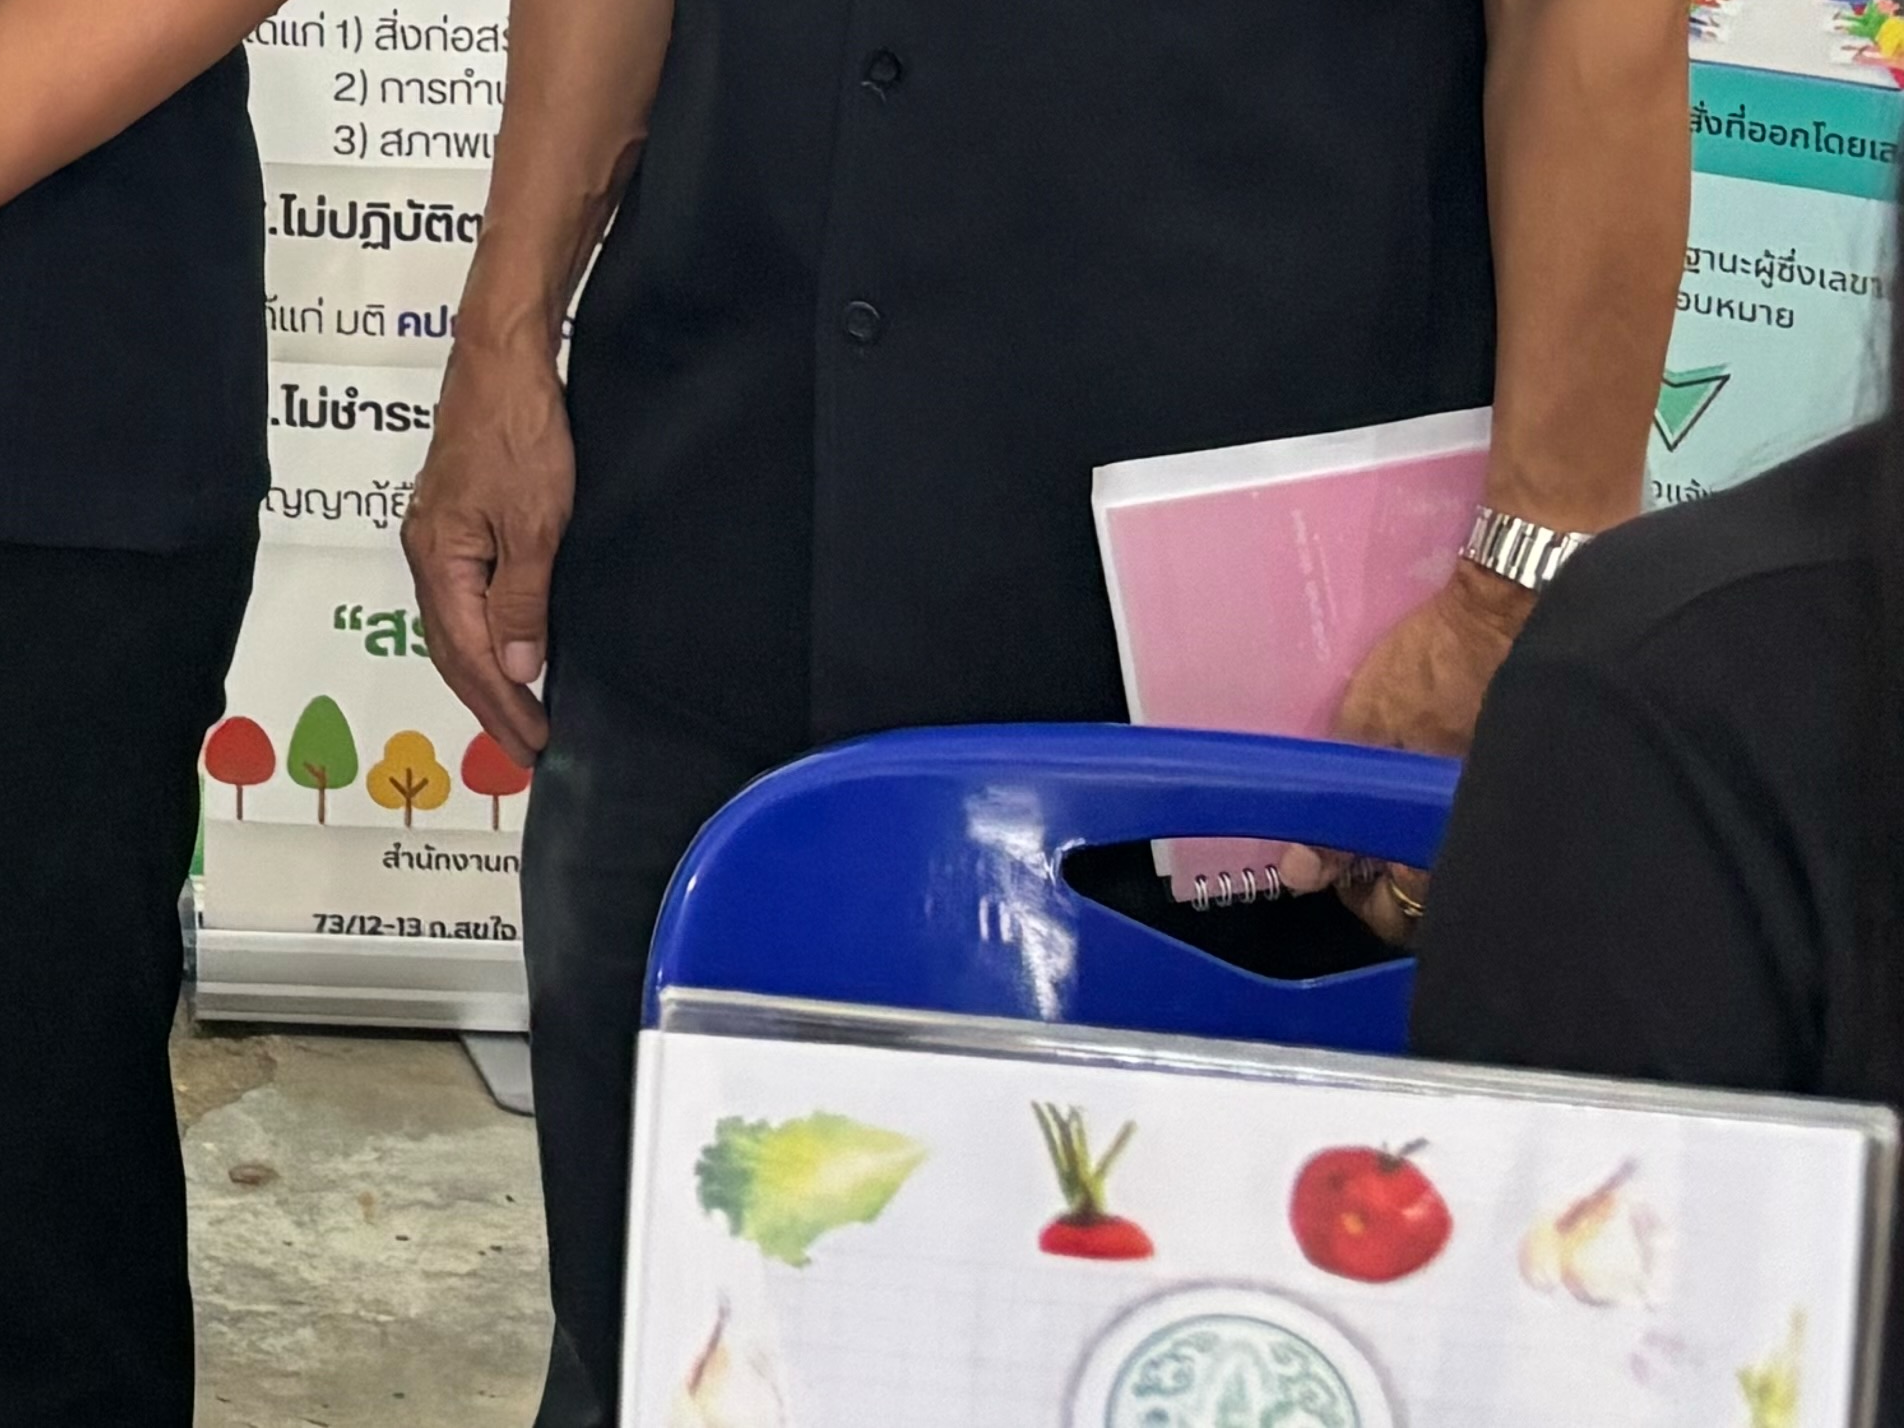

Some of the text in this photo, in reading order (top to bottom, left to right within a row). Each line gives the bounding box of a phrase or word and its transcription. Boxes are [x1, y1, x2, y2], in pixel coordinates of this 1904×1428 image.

[336, 15, 362, 54] 1)
[333, 68, 368, 107] 2)
[333, 121, 368, 160] 3)
[268, 193, 484, 249] .ไม่ปฏิบัติต
[336, 304, 386, 337] มติ
[1676, 290, 1795, 329] อบหมาย
[270, 384, 436, 432] .ไม่ชำระ
[312, 913, 422, 936] 73/12-13
